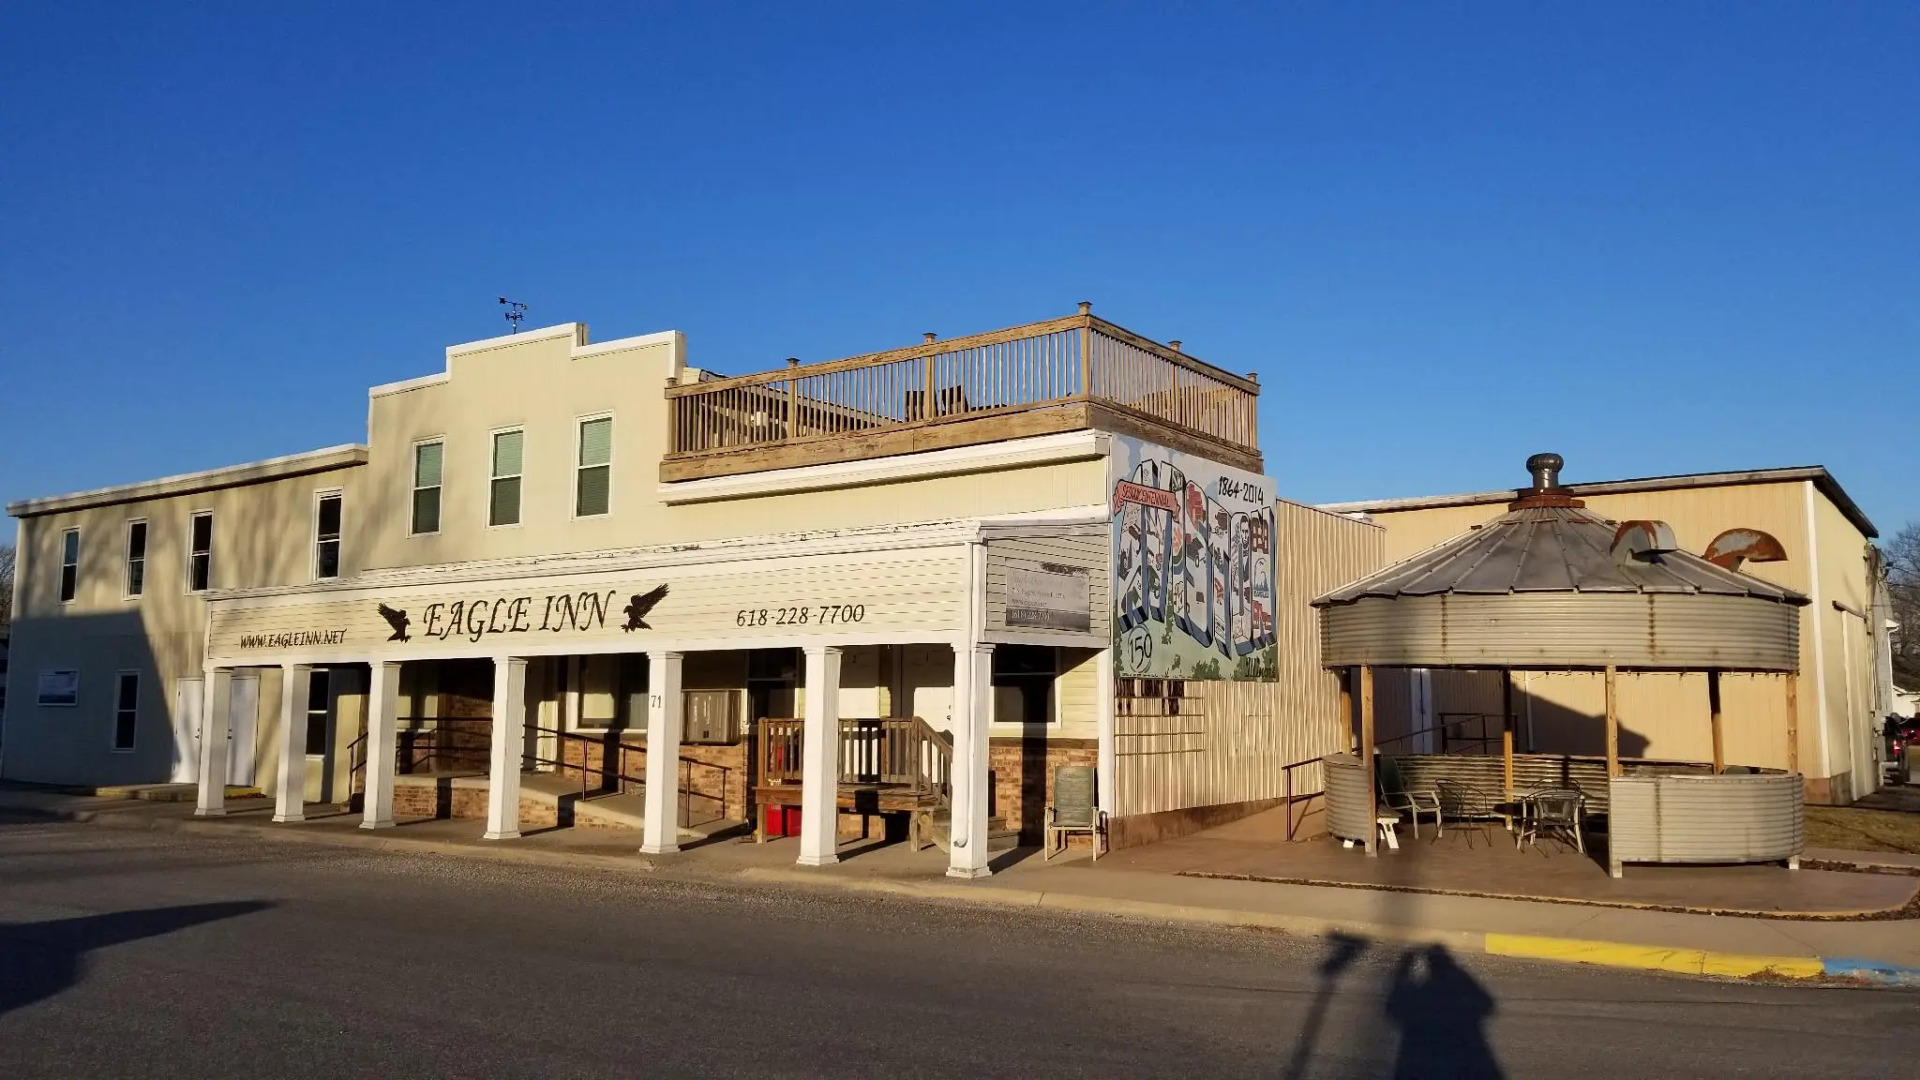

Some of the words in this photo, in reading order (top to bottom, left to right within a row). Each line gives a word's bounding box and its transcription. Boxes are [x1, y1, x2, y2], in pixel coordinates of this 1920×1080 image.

[1218, 475, 1264, 505] 1864-2014
[423, 597, 532, 643] EAGLE
[538, 589, 617, 632] INN
[736, 604, 865, 627] 618-228-7700
[240, 628, 348, 649] WWW.EAGLEINN.NET
[1129, 633, 1152, 669] 150
[650, 695, 662, 709] 71
